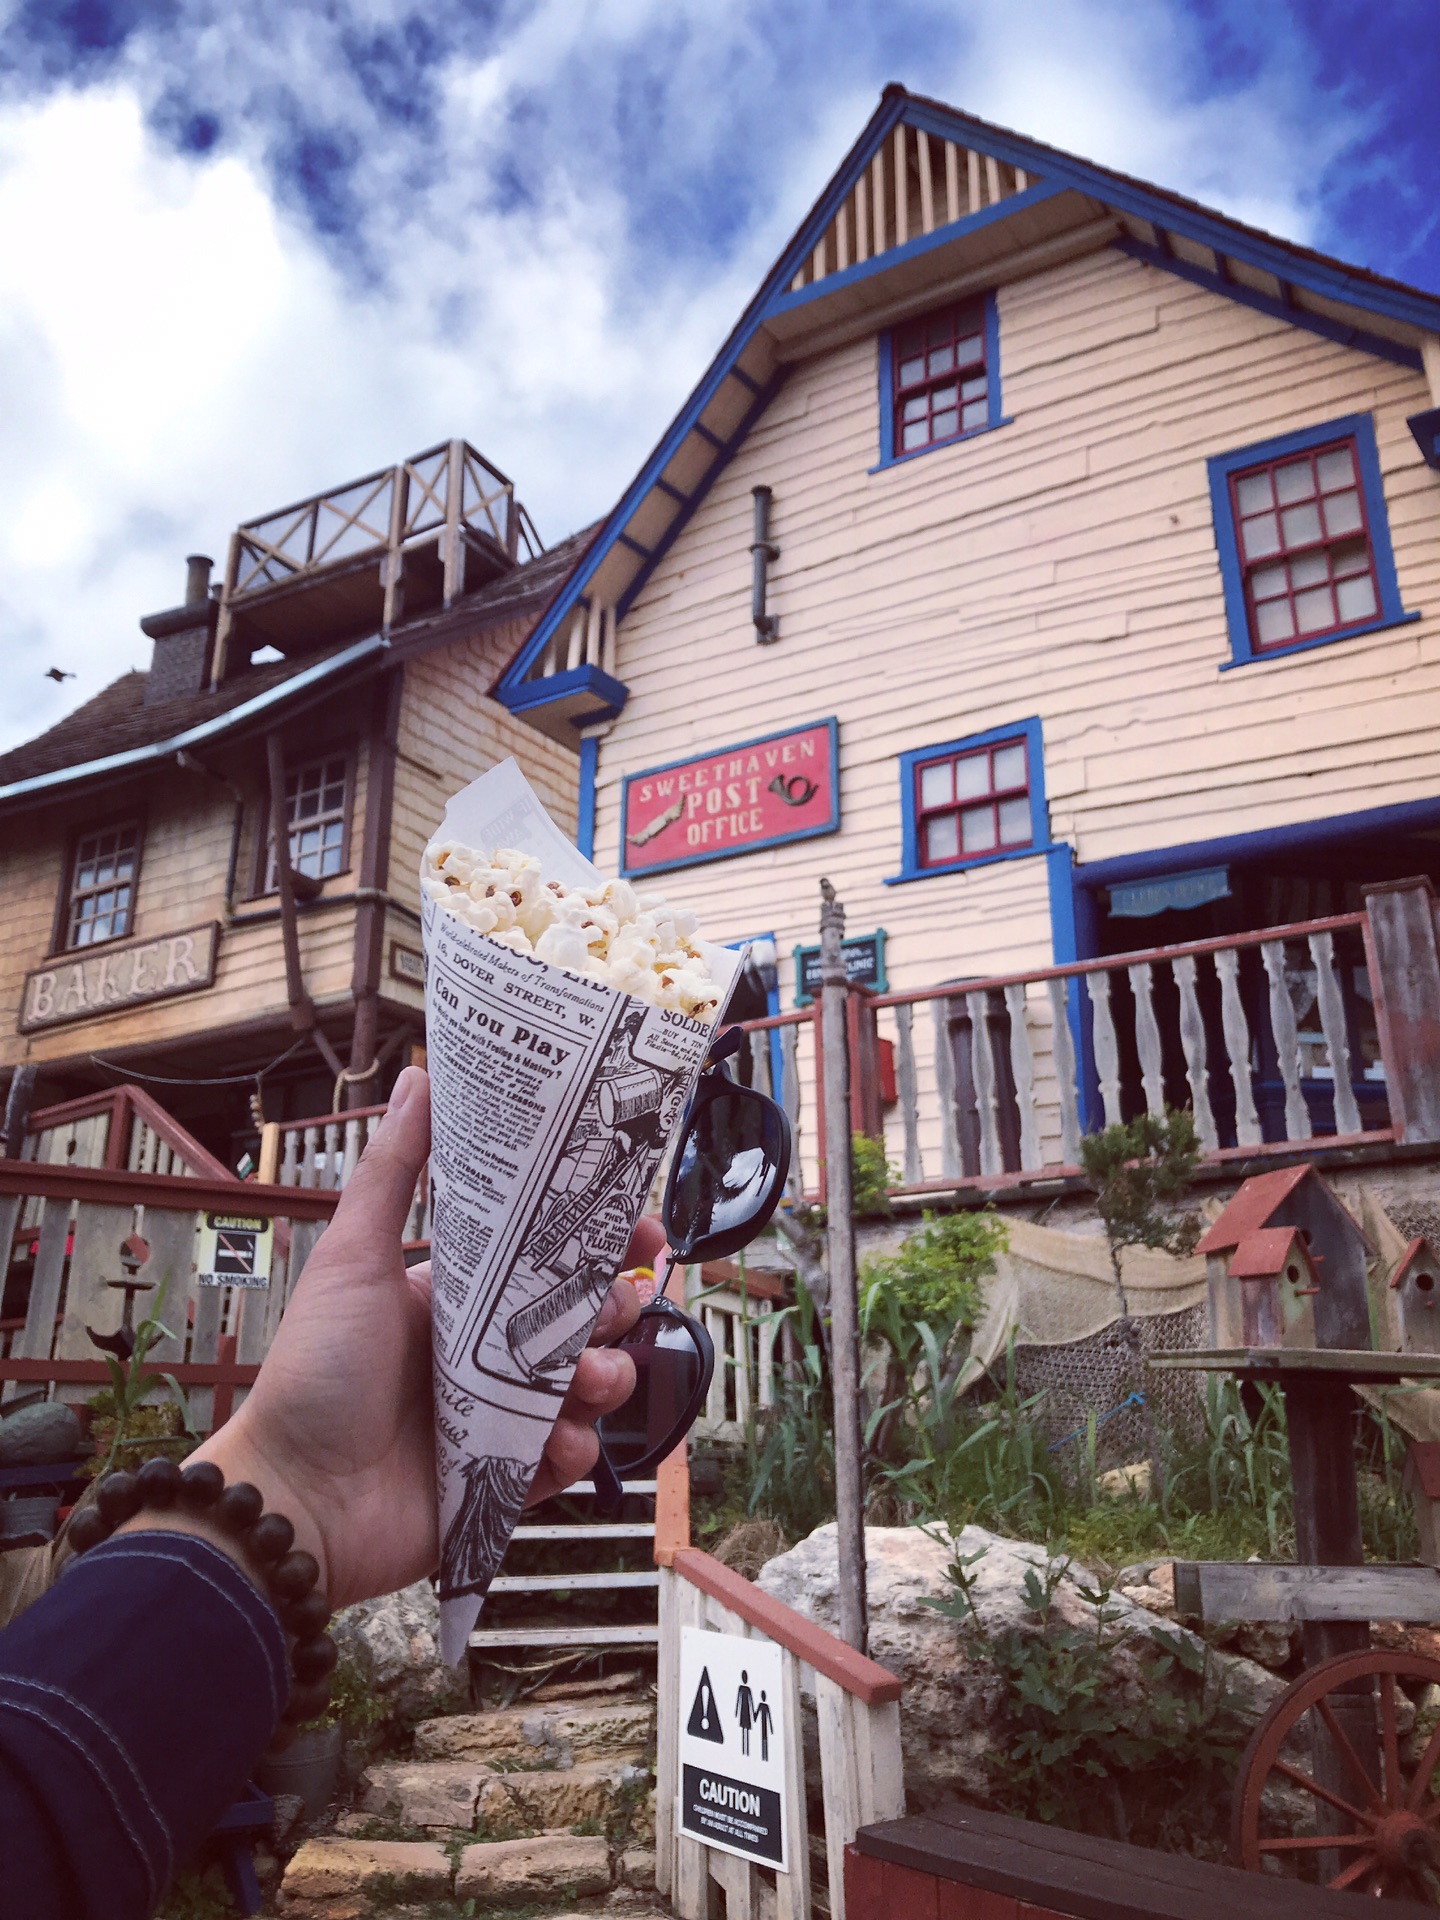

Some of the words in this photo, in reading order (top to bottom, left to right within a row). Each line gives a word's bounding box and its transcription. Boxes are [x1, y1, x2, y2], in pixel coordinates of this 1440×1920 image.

[639, 739, 815, 802] SWEETHAVEN
[687, 777, 762, 819] POST
[687, 808, 764, 846] OFFICE
[27, 935, 200, 1021] BAKER
[453, 953, 494, 985] DOVER
[503, 982, 566, 1019] STREET,
[579, 1013, 595, 1029] W.
[488, 955, 519, 976] Makers
[521, 973, 534, 983] of
[534, 975, 605, 1013] Transformations
[436, 977, 459, 1010] Can
[464, 1005, 505, 1037] you
[511, 1026, 571, 1066] Play
[662, 1028, 679, 1039] BUY
[471, 1034, 486, 1046] with
[514, 1054, 521, 1063] &
[647, 1033, 660, 1041] All
[506, 1091, 546, 1113] LESSONS
[213, 1215, 262, 1230] CAUTION
[589, 1218, 610, 1229] MUST
[611, 1224, 630, 1236] HAVE
[604, 1212, 624, 1224] THEY
[585, 1234, 626, 1255] FLUXIT
[199, 1274, 214, 1284] NO
[217, 1275, 267, 1287] SMOKING
[700, 1778, 760, 1817] CAUTION
